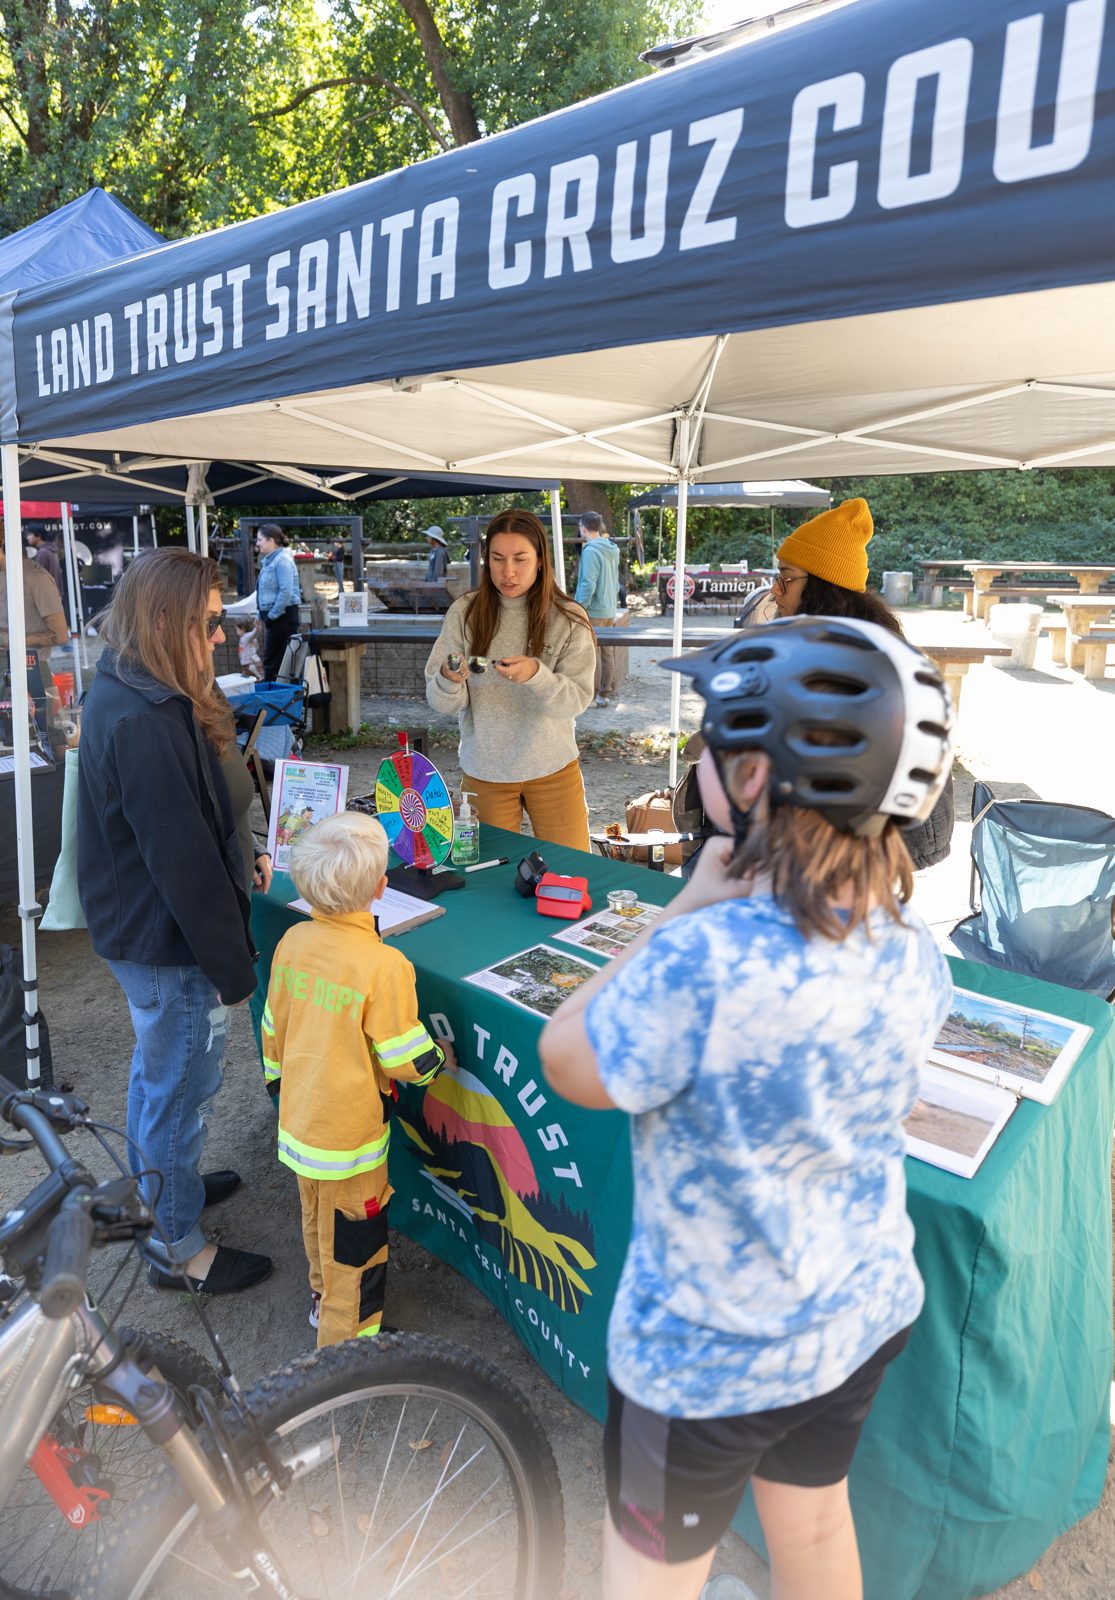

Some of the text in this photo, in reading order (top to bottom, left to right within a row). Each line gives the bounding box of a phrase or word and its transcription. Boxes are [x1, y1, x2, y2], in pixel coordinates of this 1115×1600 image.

[35, 0, 1107, 397] LAND TRUST SANTA CRUZ COU
[45, 522, 111, 531] URNOT.COM
[698, 577, 756, 593] Tamien
[426, 789, 444, 803] patch
[313, 977, 365, 1021] DEPT
[473, 1023, 583, 1188] TRUST
[412, 1198, 591, 1379] SANTA CRU COUNTY
